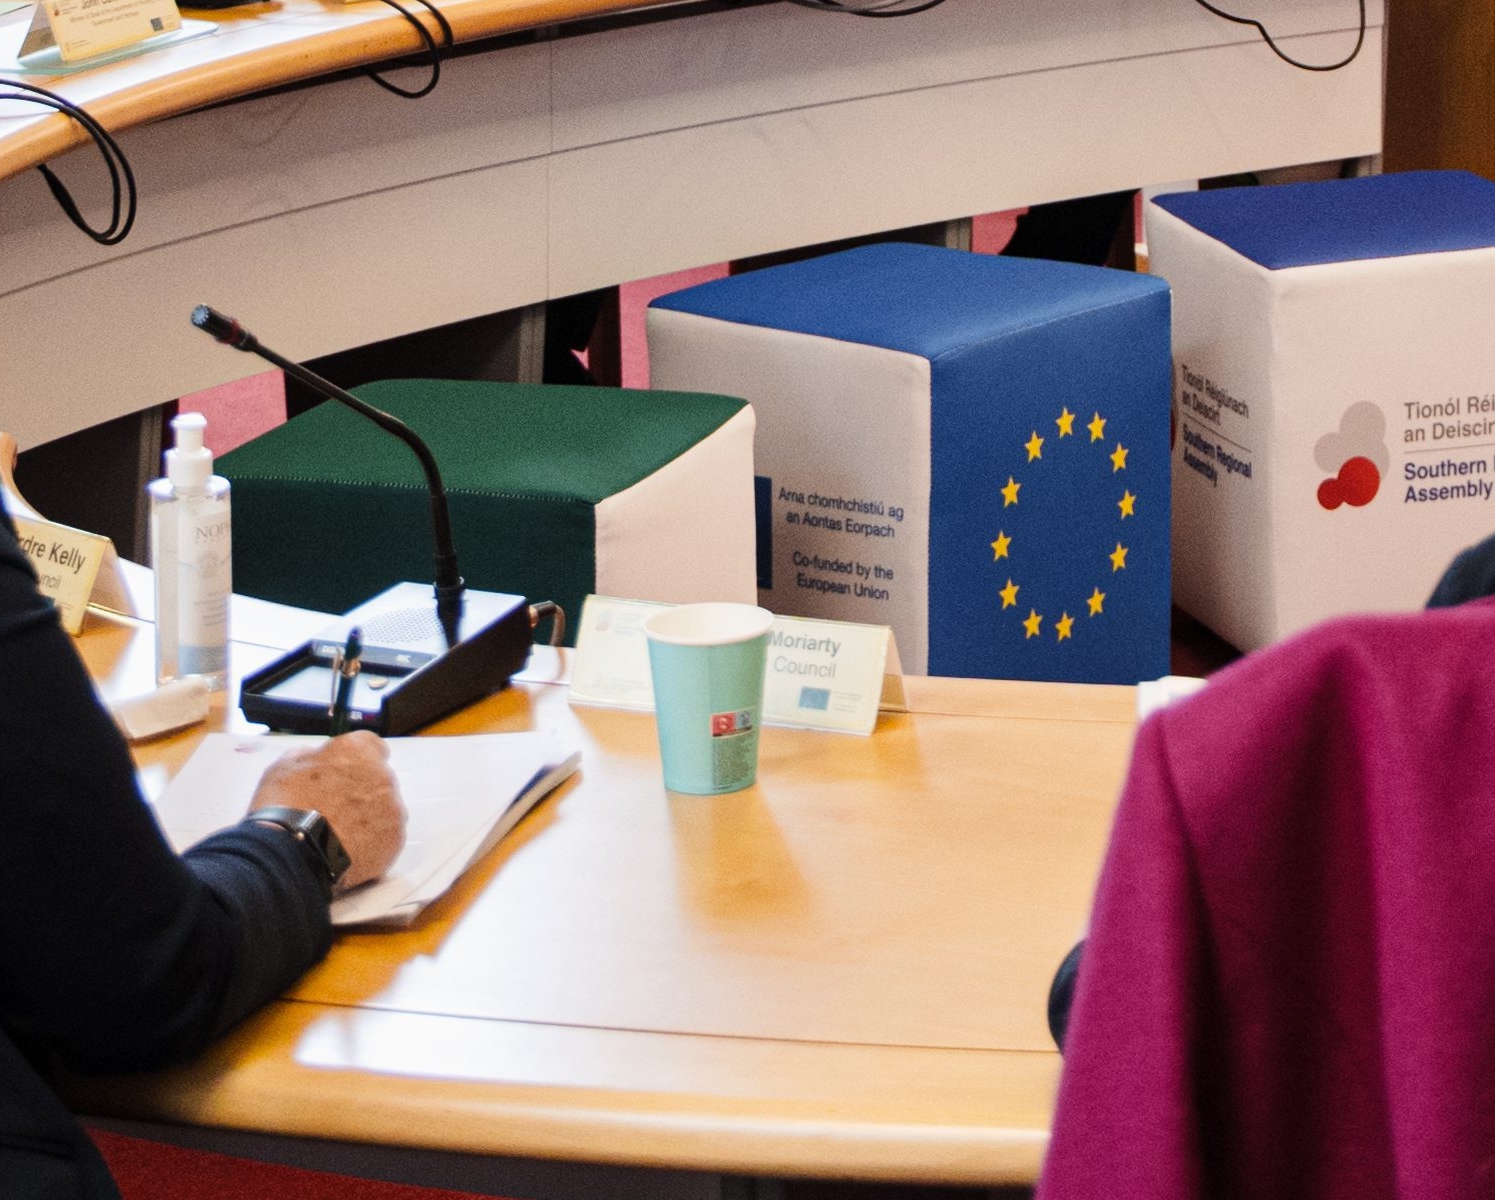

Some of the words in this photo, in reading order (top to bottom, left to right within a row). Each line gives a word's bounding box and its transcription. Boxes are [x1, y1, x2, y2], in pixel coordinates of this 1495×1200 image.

[1182, 364, 1204, 392] Tionól
[1404, 397, 1460, 420] Tionól
[1404, 426, 1425, 442] an
[1183, 423, 1215, 460] Southern
[1216, 444, 1252, 479] Regional
[1183, 447, 1218, 487] Assembly
[1404, 459, 1486, 481] Southern
[779, 487, 805, 504] Arna
[888, 506, 904, 521] ag
[1404, 479, 1494, 503] Assembly
[786, 511, 801, 523] an
[803, 512, 842, 531] Aontas
[846, 518, 895, 538] Eorpach
[48, 541, 86, 574] Kelly
[793, 551, 853, 574] Co-funded
[856, 562, 871, 580] by
[874, 566, 894, 580] the
[797, 573, 850, 594] European
[854, 583, 890, 600] Union
[767, 630, 842, 657] Moriarty
[774, 655, 837, 679] Council
